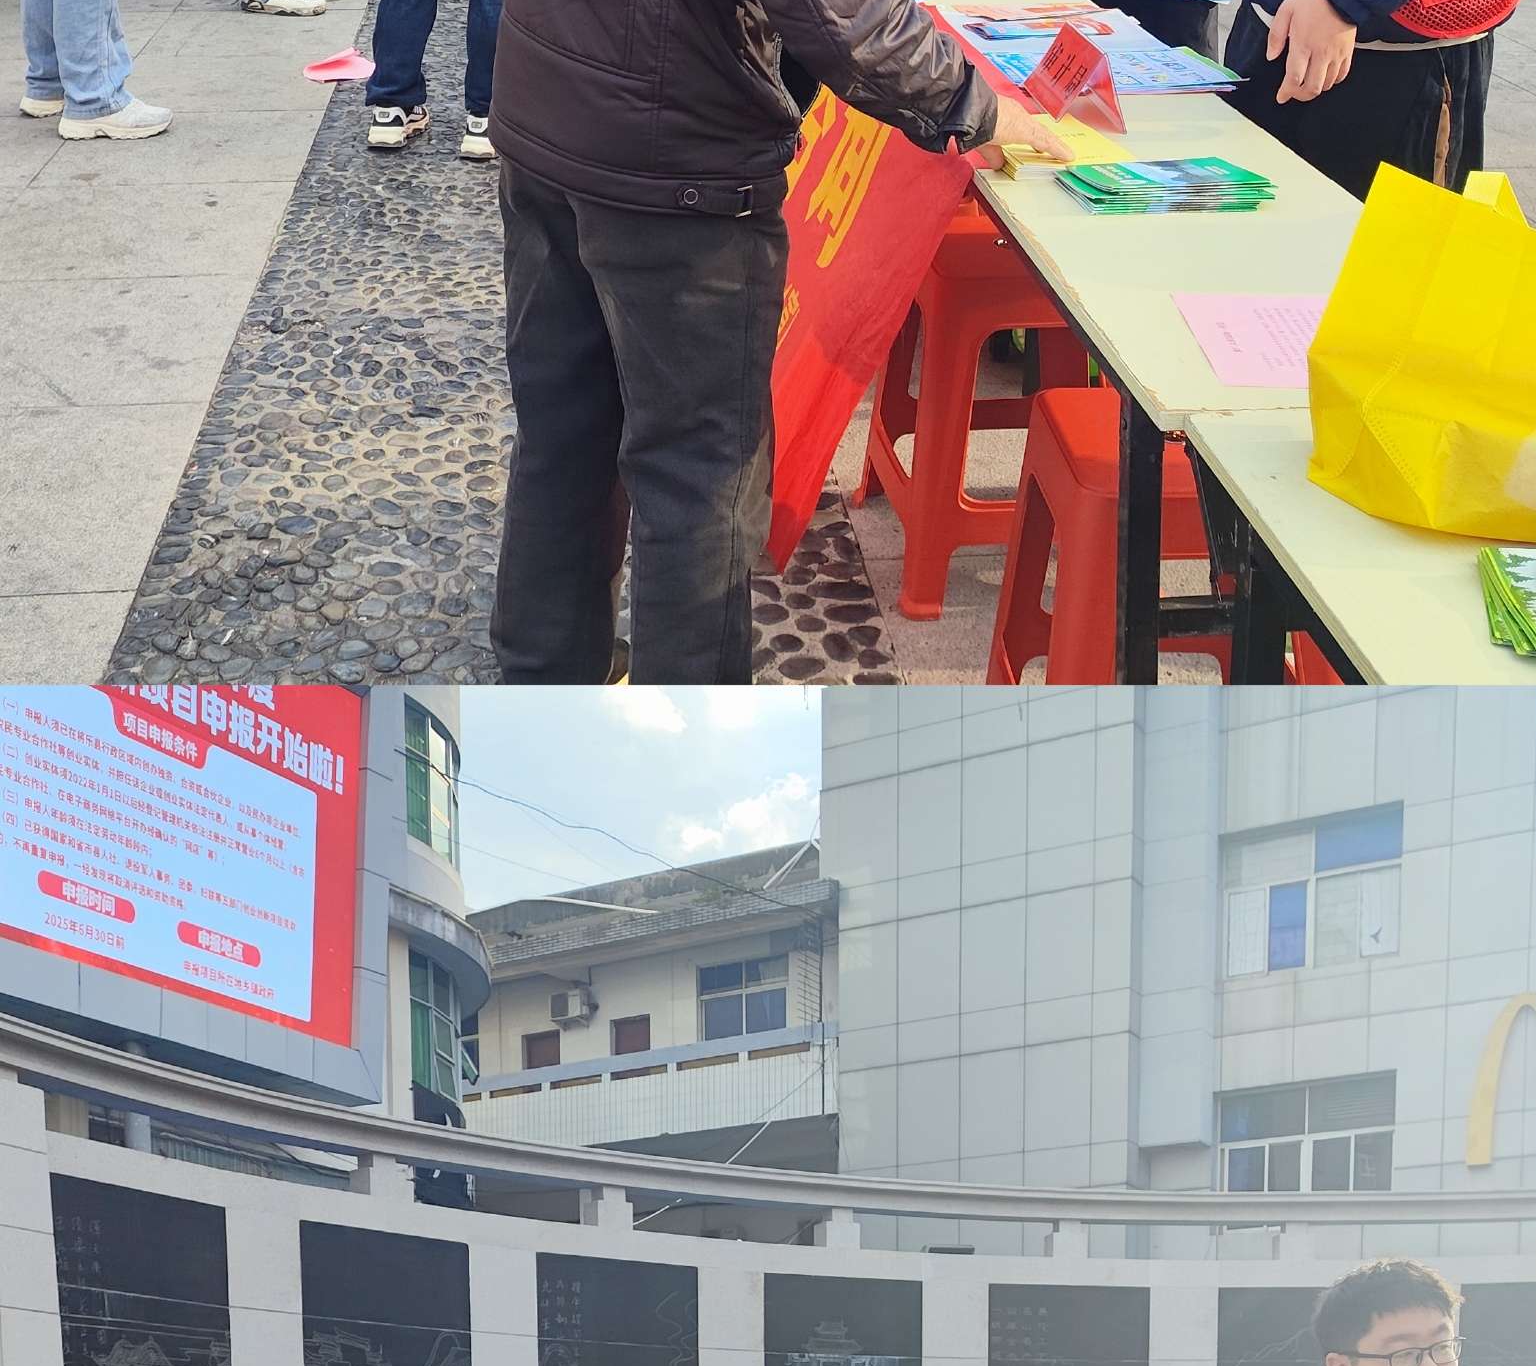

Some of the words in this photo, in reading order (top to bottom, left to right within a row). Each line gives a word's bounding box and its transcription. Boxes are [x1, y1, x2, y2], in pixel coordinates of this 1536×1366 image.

[1042, 42, 1087, 101] 审计局
[122, 711, 199, 763] 项目申报条件
[61, 880, 117, 916] 申报时间
[197, 930, 245, 962] 申报地点
